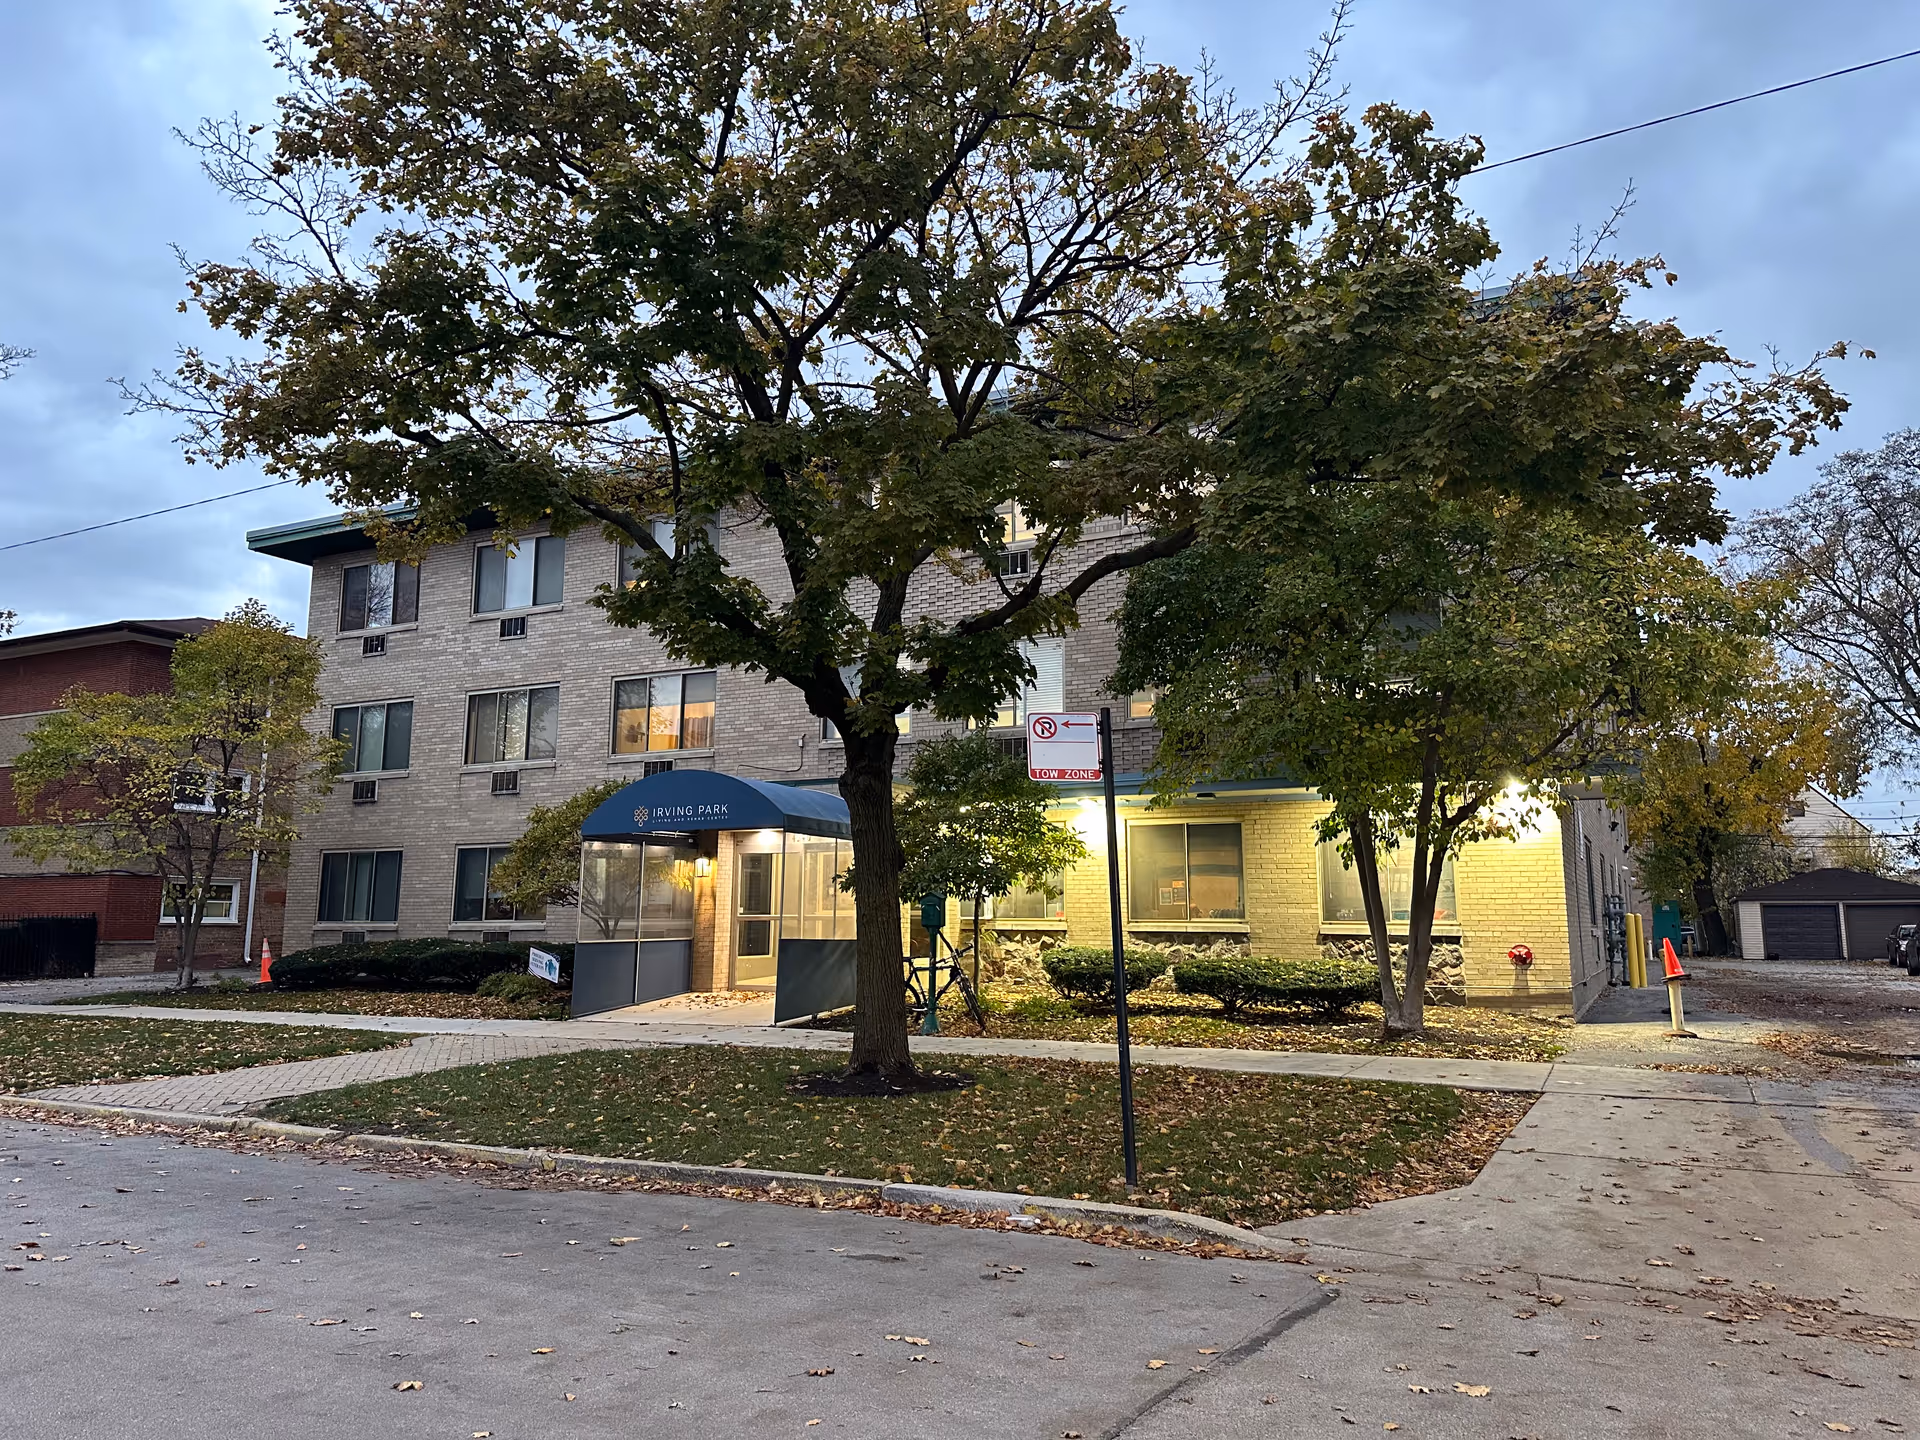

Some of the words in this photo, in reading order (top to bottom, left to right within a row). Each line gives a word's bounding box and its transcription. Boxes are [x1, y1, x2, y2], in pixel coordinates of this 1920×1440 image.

[1034, 769, 1058, 778] TOW
[1064, 770, 1096, 779] ZONE
[652, 806, 692, 817] IRVING
[698, 804, 728, 814] PARK
